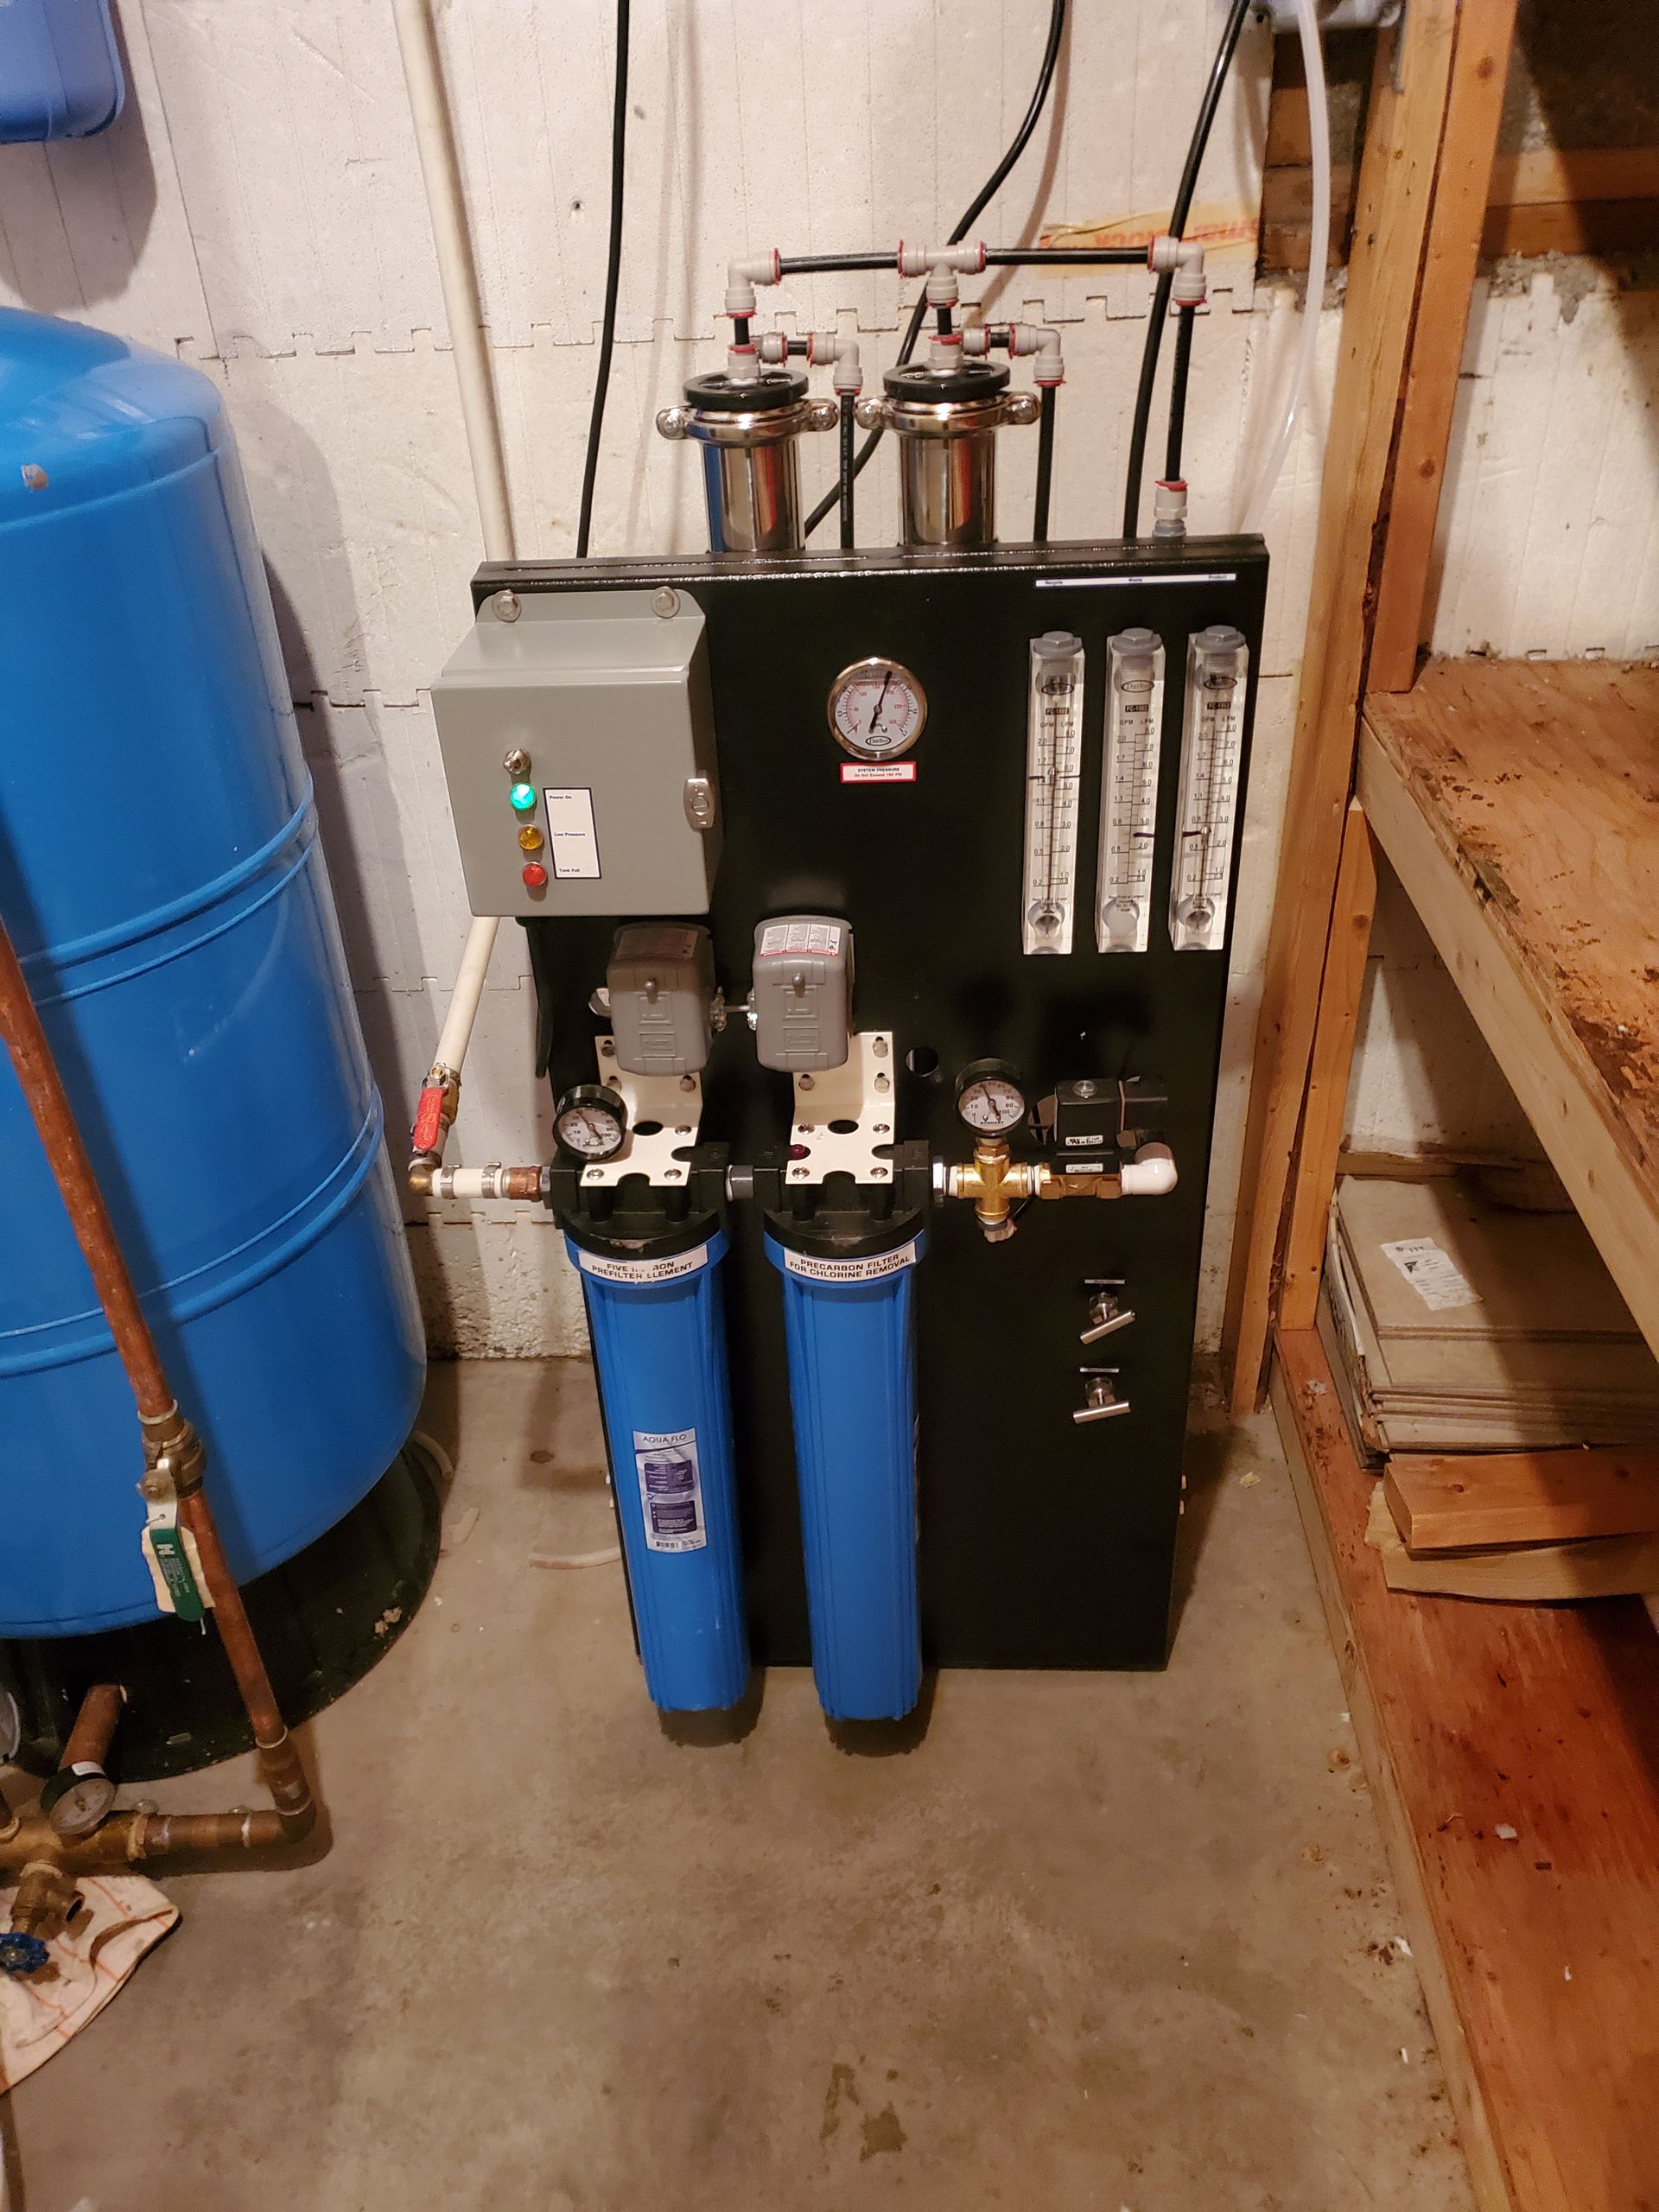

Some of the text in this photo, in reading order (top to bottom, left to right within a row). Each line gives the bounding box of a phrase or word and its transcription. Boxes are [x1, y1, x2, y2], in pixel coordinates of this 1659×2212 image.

[607, 1263, 628, 1272] FIVE
[790, 1255, 910, 1279] FOR CHLORINE REMOVAL
[800, 1254, 899, 1271] PRECARBON FILTER
[592, 1265, 643, 1279] PREFILTER
